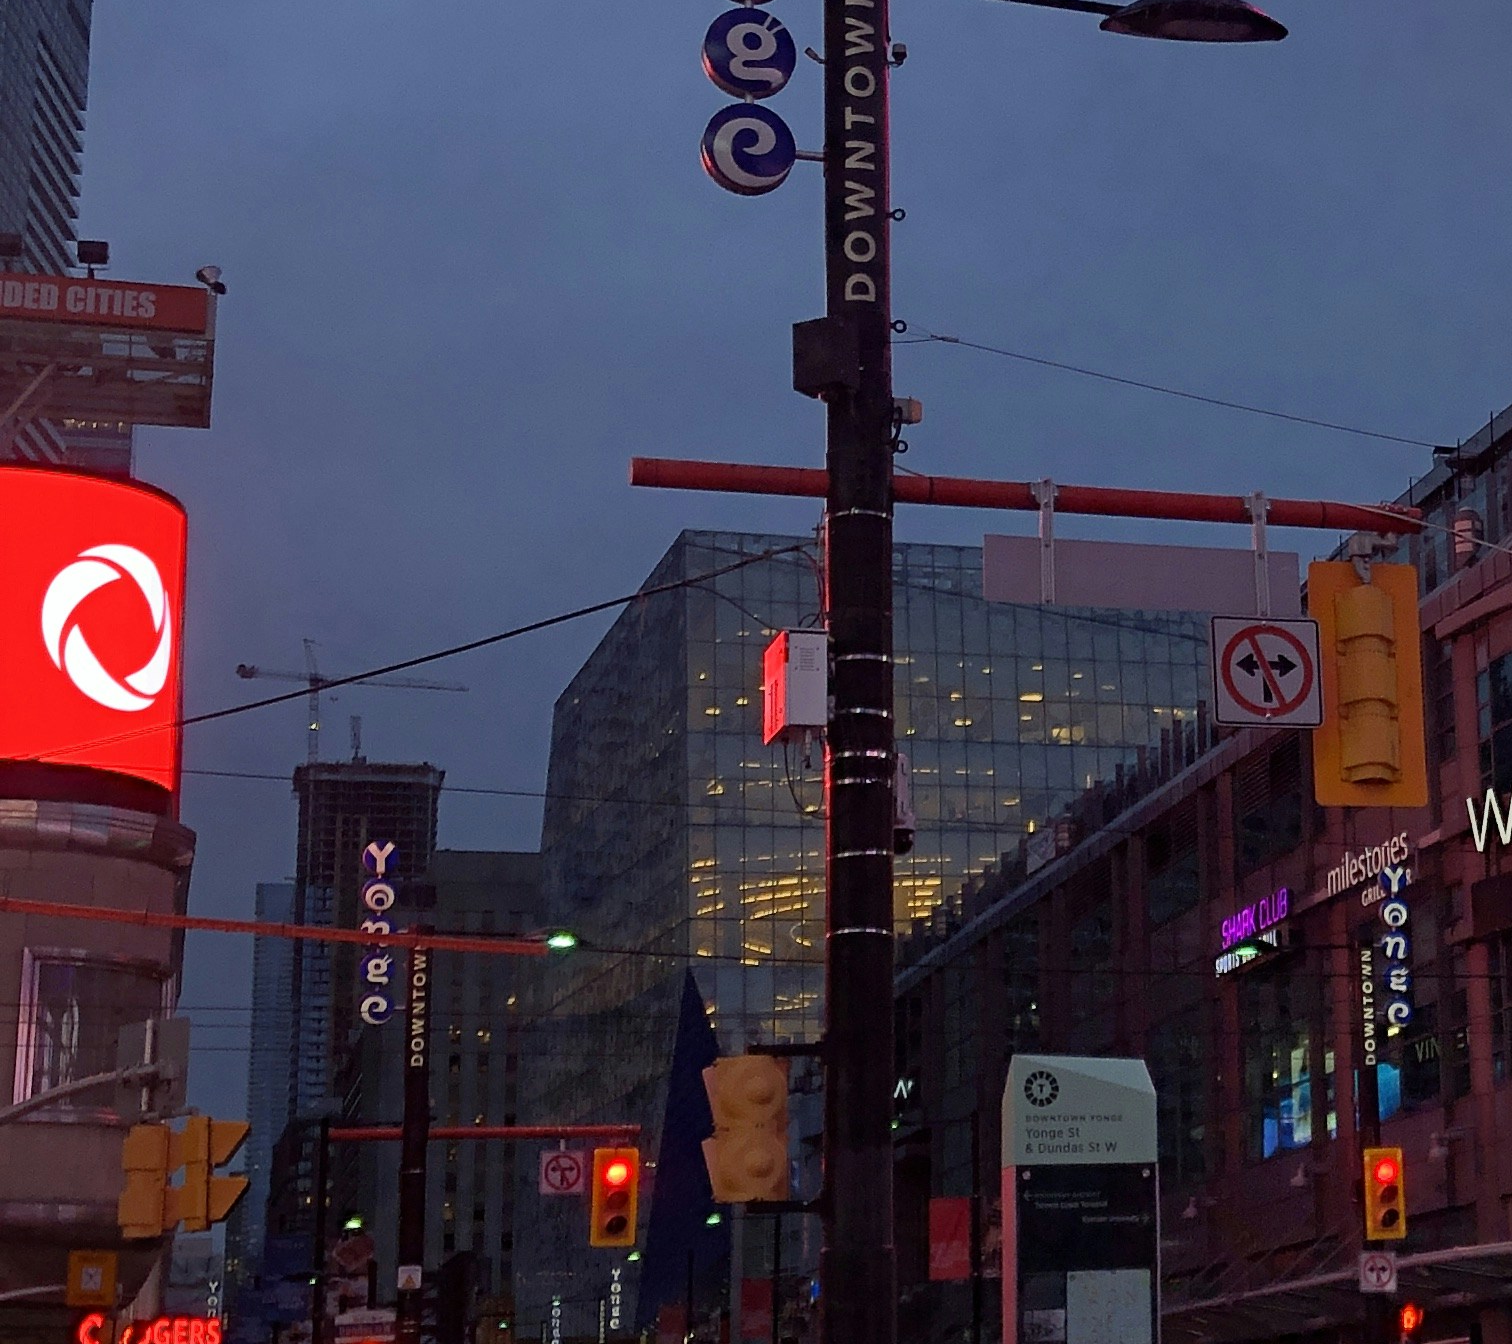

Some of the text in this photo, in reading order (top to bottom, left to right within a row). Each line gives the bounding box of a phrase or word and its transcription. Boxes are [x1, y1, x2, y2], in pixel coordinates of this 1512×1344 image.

[66, 286, 156, 318] CITIES
[1328, 832, 1408, 897] milestones
[1260, 887, 1287, 930] CLUB
[1361, 950, 1376, 1066] DOWNTOWN
[1025, 1127, 1080, 1140] Yonge St
[1025, 1141, 1117, 1154] & Dundas St W
